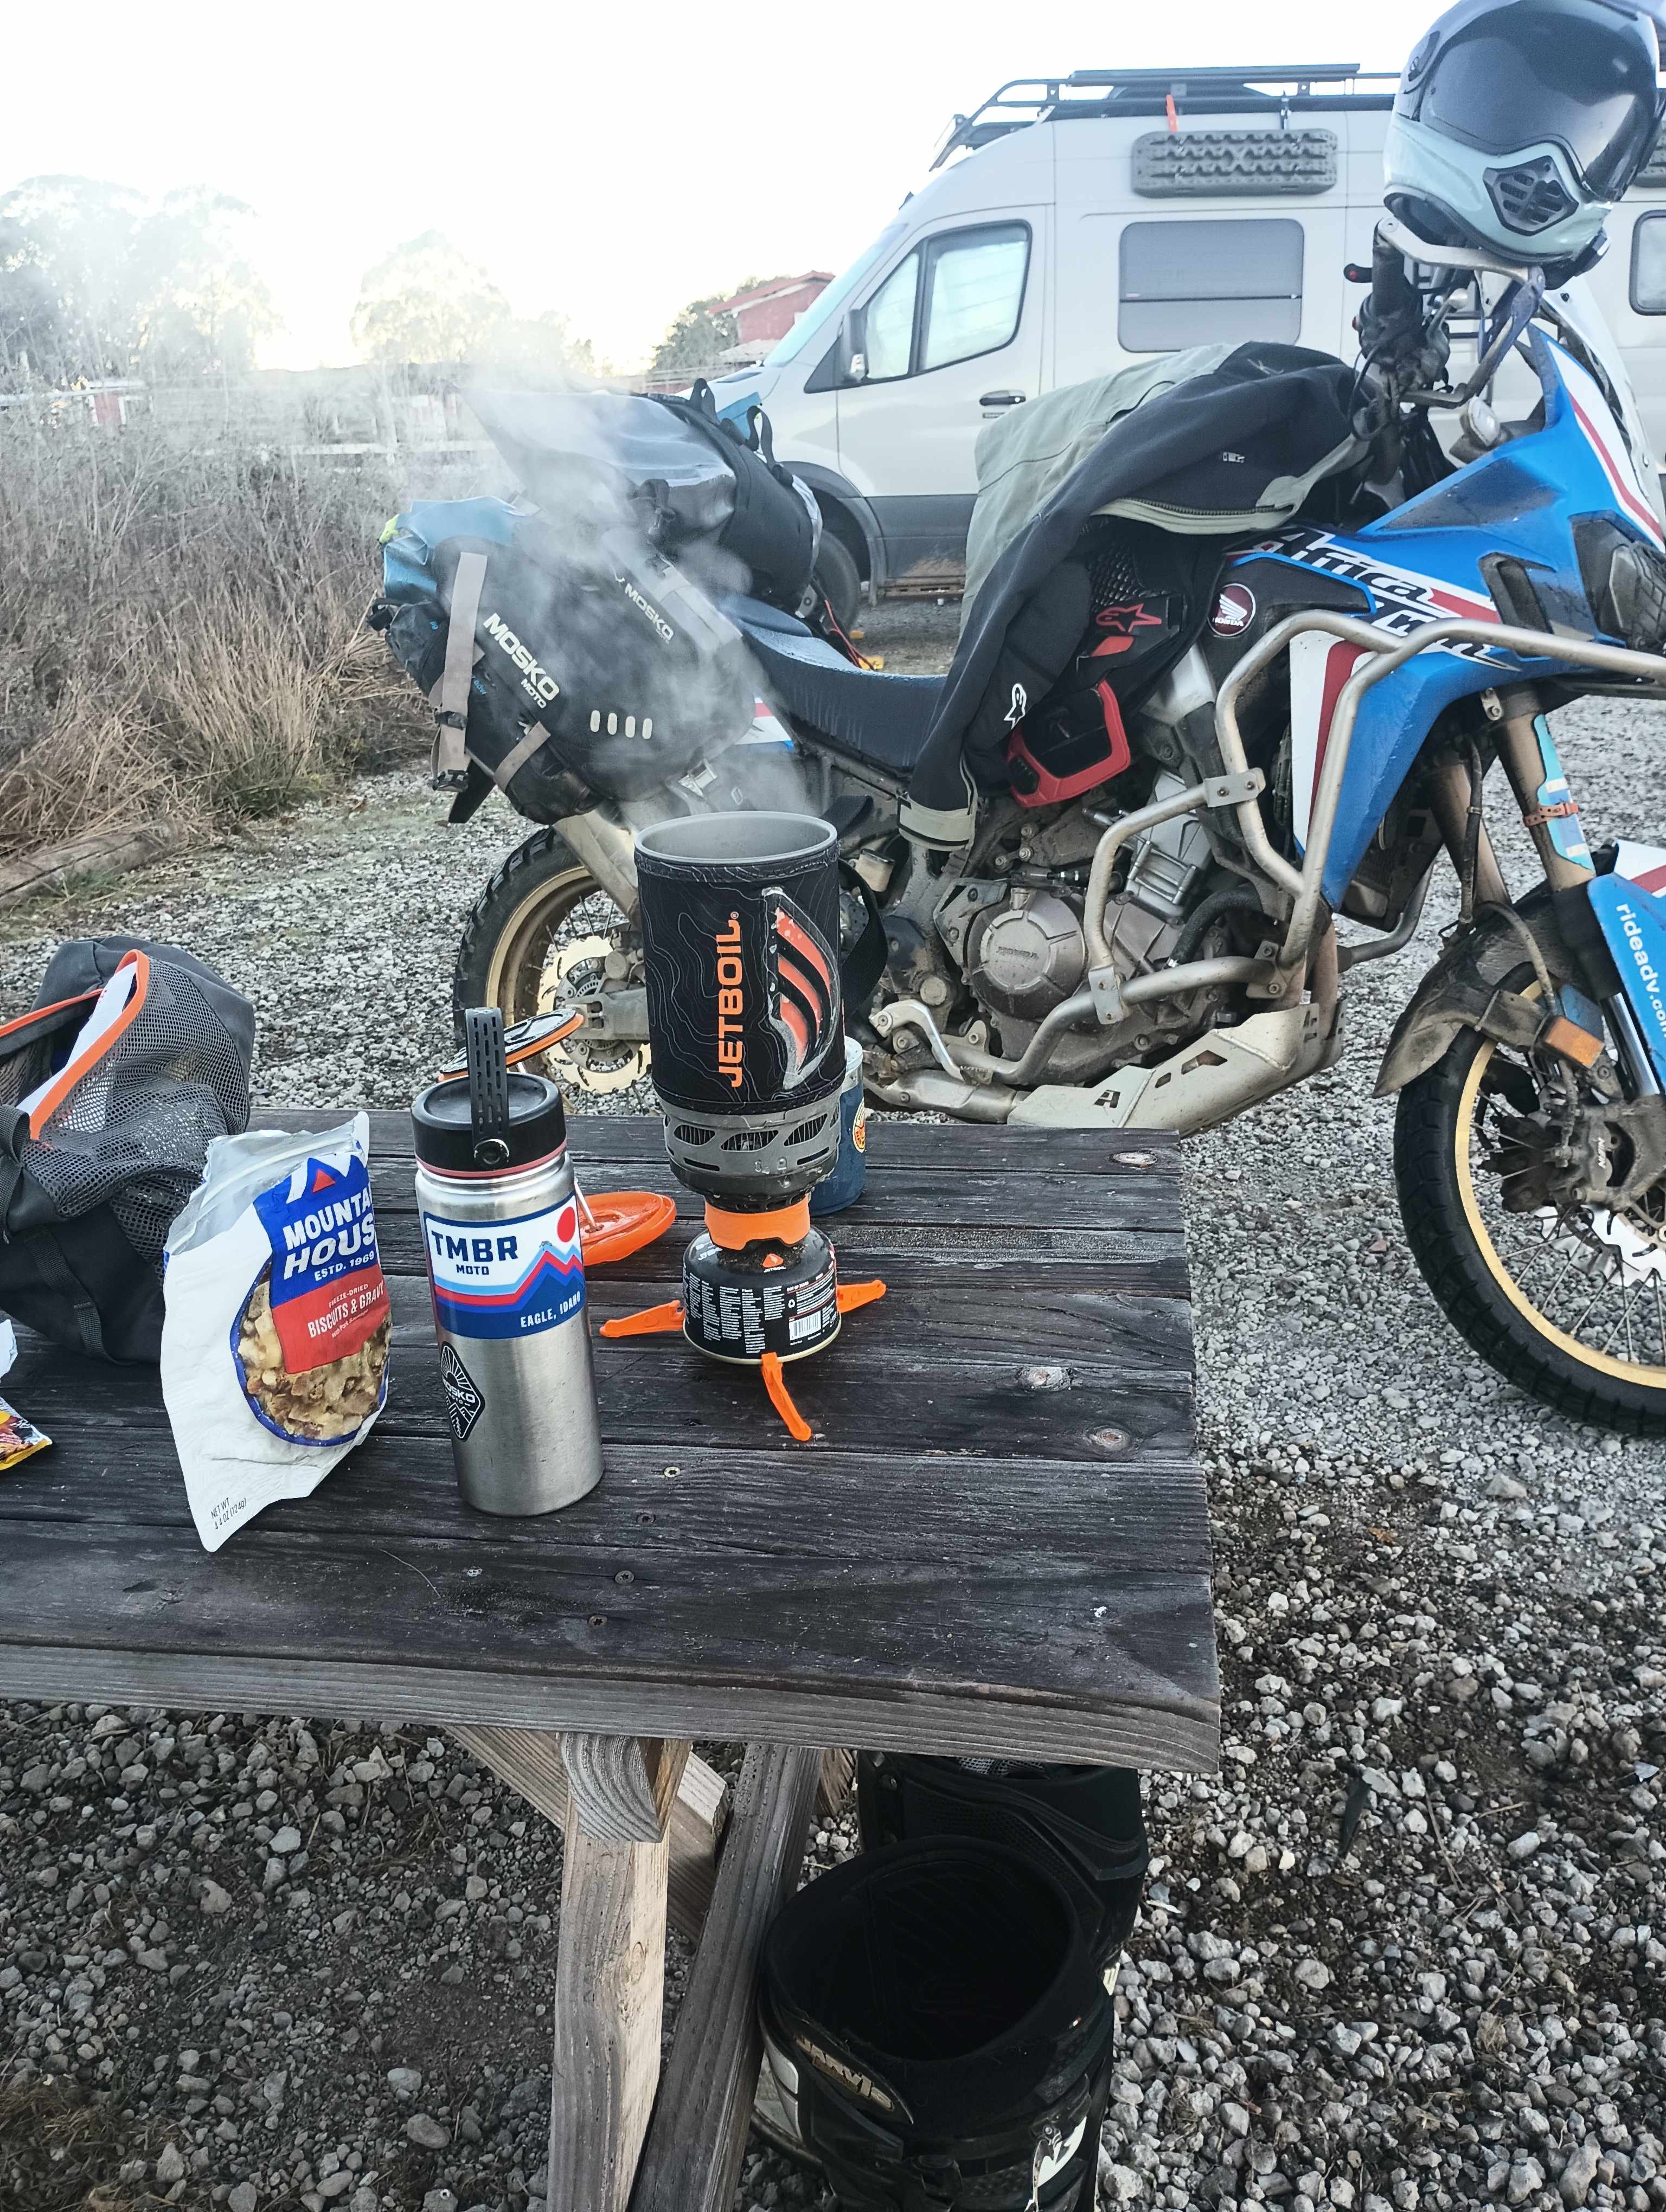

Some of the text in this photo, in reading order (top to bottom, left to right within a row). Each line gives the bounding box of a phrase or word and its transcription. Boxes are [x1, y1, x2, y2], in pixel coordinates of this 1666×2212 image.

[625, 583, 675, 640] MOSKO
[483, 613, 560, 700] MOSKO
[521, 678, 547, 708] MOTO
[283, 1187, 371, 1250] MOUNTA
[284, 1213, 375, 1280] HOUS
[431, 1230, 518, 1262] TMBR
[314, 1250, 374, 1281] ESTD. 1969
[456, 1264, 490, 1275] MOTO
[307, 1279, 384, 1338] BISCUITS & GRAVY
[329, 1283, 369, 1308] FREEZE-DRIED
[520, 1290, 581, 1328] EAGLE, IDAHO
[210, 1497, 229, 1519] NET WT
[215, 1497, 247, 1529] 44 OZ (124g)
